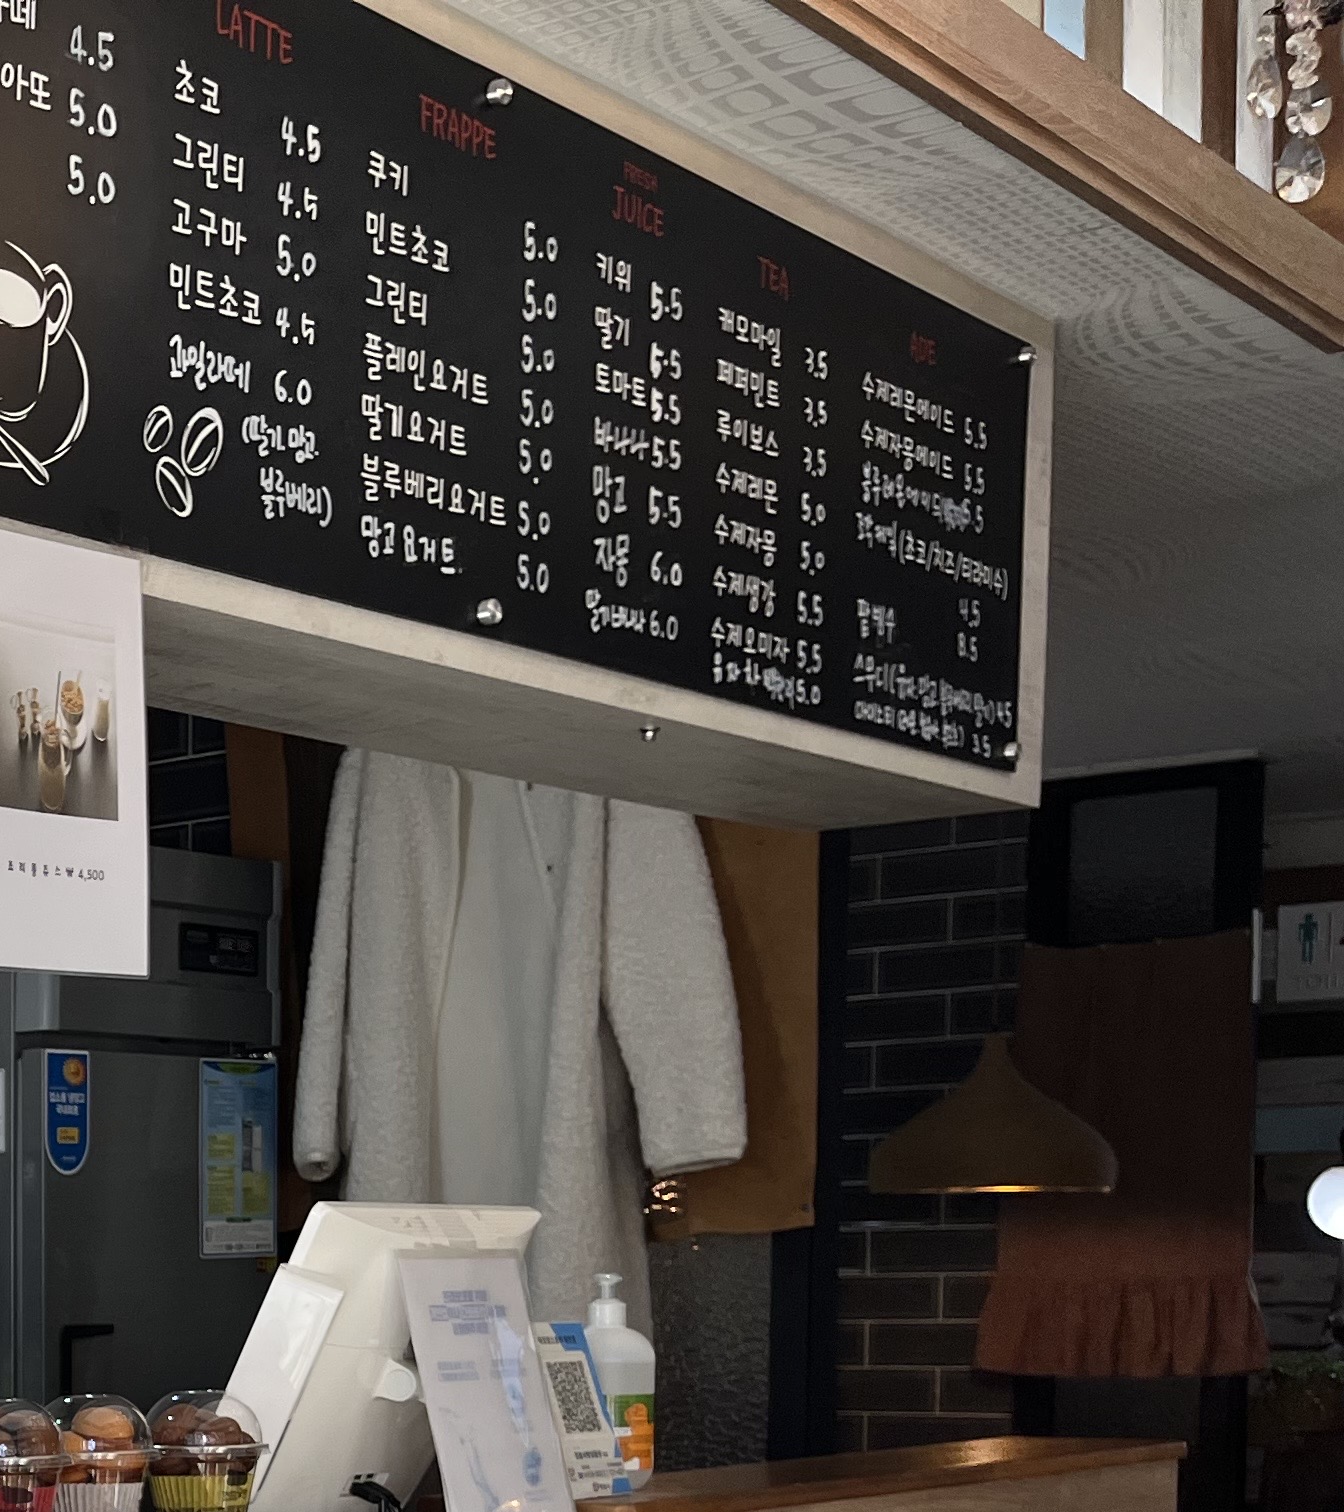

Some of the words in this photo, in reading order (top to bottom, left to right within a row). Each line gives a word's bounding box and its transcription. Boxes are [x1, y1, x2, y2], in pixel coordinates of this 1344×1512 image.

[68, 25, 114, 71] 4.5
[216, 0, 293, 64] LATTE
[174, 59, 220, 114] 초코
[68, 87, 117, 137] 5.0
[419, 93, 497, 159] FRAPPE
[281, 116, 321, 163] 4.5
[67, 154, 116, 205] 5.0
[173, 133, 244, 192] 그린티
[368, 150, 409, 197] 쿠키
[277, 181, 318, 220] 4.5
[612, 185, 664, 237] JUICE
[171, 198, 247, 256] 고구마
[366, 210, 450, 272] 민트초코
[523, 221, 558, 262] 5.0
[276, 234, 317, 282] 5.0
[596, 252, 632, 293] 키위
[757, 255, 790, 301] TEA
[169, 263, 261, 325] 민트초코
[365, 274, 427, 326] 그린티
[522, 278, 557, 322] 5.0
[650, 281, 683, 321] 5.5
[275, 307, 315, 345] 4.5
[594, 305, 630, 350] 딸기
[363, 332, 489, 405] 플레인요거트
[520, 334, 555, 373] 5.0
[649, 341, 682, 380] 5.5
[805, 347, 828, 380] 3.5
[274, 370, 313, 405] 6.0
[594, 362, 647, 407] 토마토
[716, 358, 780, 407] 페퍼민트
[862, 371, 955, 433] 수제레몬에이드
[362, 393, 467, 456] 딸기요거트
[519, 388, 554, 428] 5.0
[650, 386, 681, 425] 5.5
[804, 397, 827, 428] 3.5
[594, 416, 649, 461] 바나나
[651, 436, 681, 470] 5.5
[716, 409, 779, 457] 루이보스
[862, 419, 954, 479] 수제자몽에이드
[964, 417, 987, 450] 5.5
[518, 438, 553, 484] 5.0
[803, 446, 827, 477] 3.5
[964, 463, 985, 495] 5.5
[360, 453, 507, 526] 블루베리요거트
[593, 465, 627, 524] 망고
[649, 485, 682, 528] 5.5
[715, 461, 779, 514] 수제레몬
[801, 492, 826, 526] 5.0
[517, 500, 550, 541] 5.0
[714, 513, 777, 567] 수제자몽
[516, 553, 550, 594] 5.0
[593, 533, 630, 587] 자몽
[650, 551, 683, 586] 6.0
[800, 541, 825, 576] 5.0
[650, 609, 679, 641] 6.0
[797, 590, 824, 627] 5.5
[711, 617, 790, 664] 수제오미자
[797, 639, 823, 674] 5.5
[795, 678, 821, 705] 5.0
